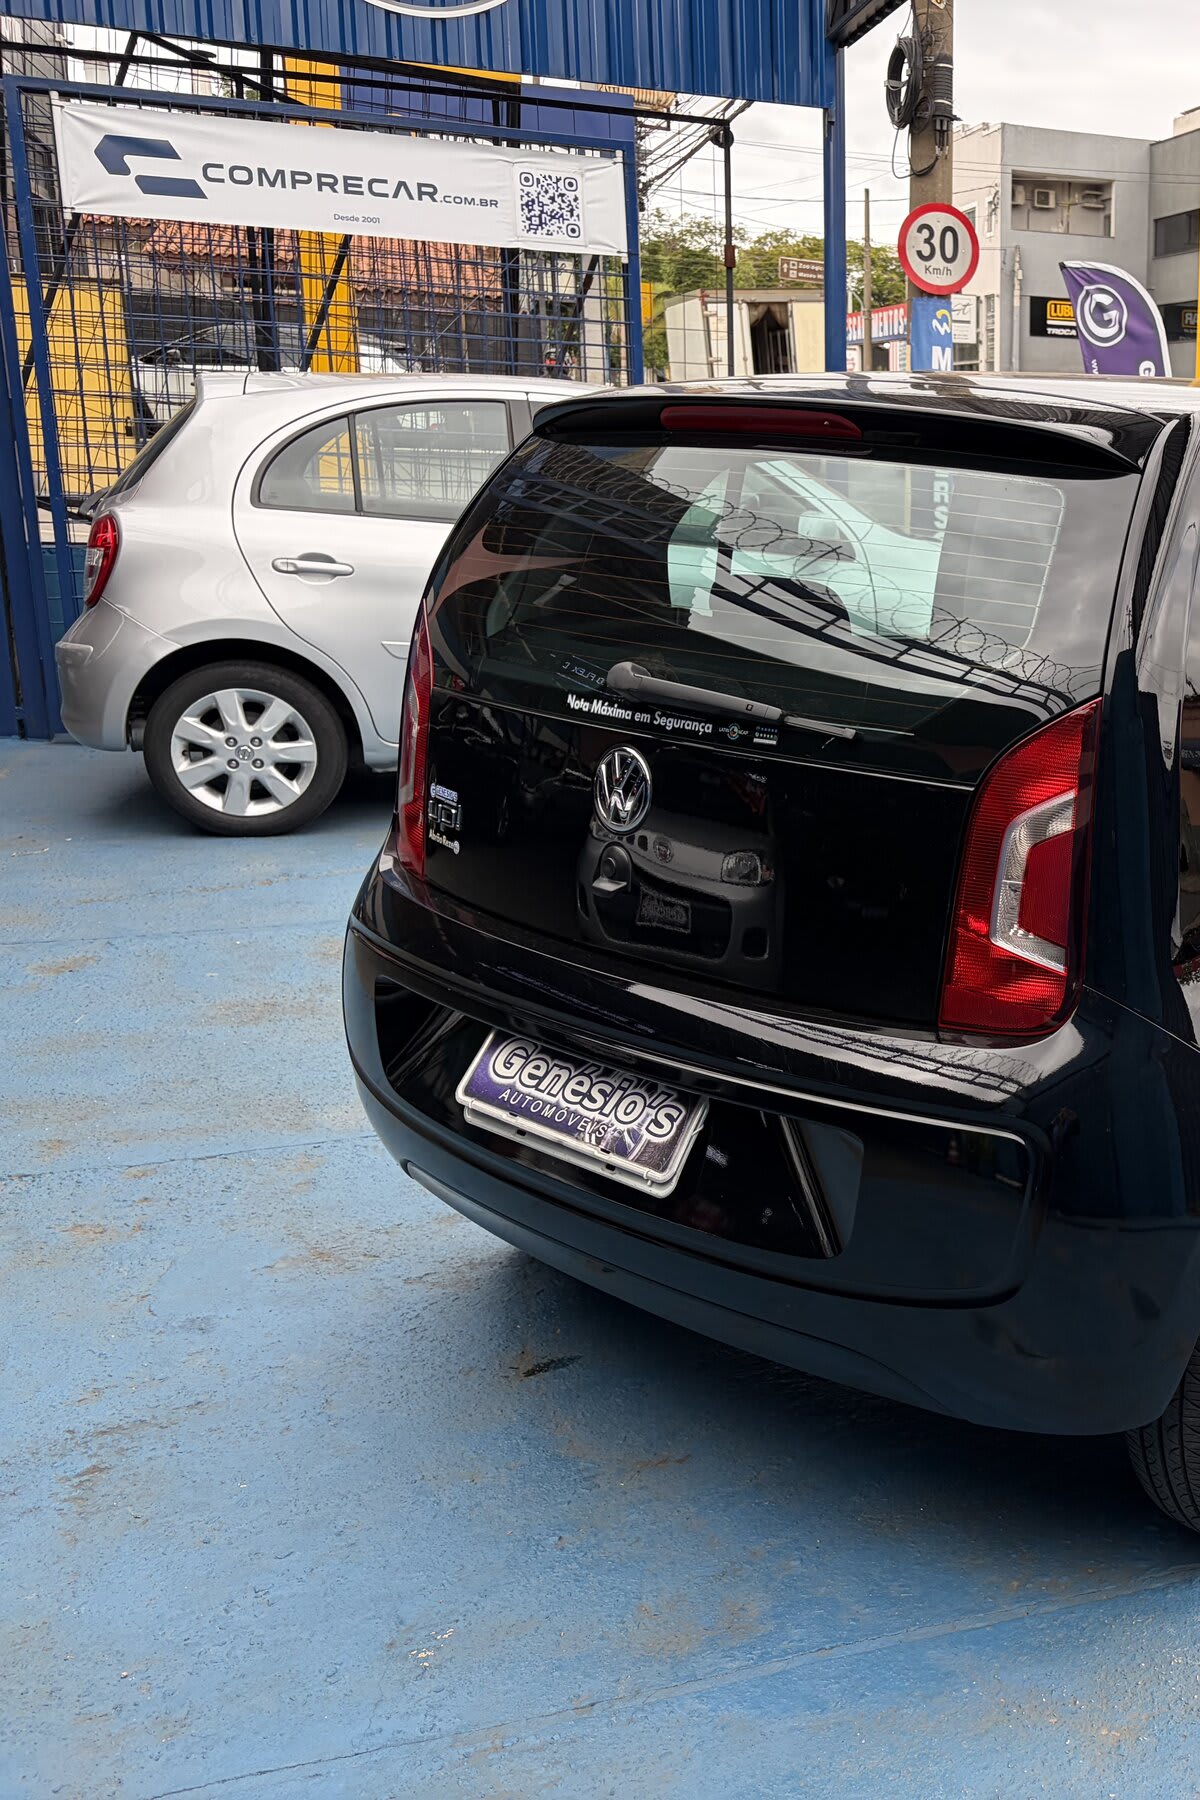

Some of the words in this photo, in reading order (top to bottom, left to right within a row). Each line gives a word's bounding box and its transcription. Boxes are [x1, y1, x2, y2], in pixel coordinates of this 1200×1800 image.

[333, 213, 360, 223] Desde
[361, 215, 381, 225] 2001
[916, 223, 959, 265] 30
[924, 265, 952, 277] Km/h
[1046, 328, 1077, 336] TROCA
[567, 693, 590, 712] Nota
[590, 699, 632, 720] Máxima
[634, 713, 651, 724] em
[653, 711, 713, 736] Segurança
[492, 1036, 685, 1139] Genésio's
[498, 1088, 609, 1138] AUTOMÓVEIS
